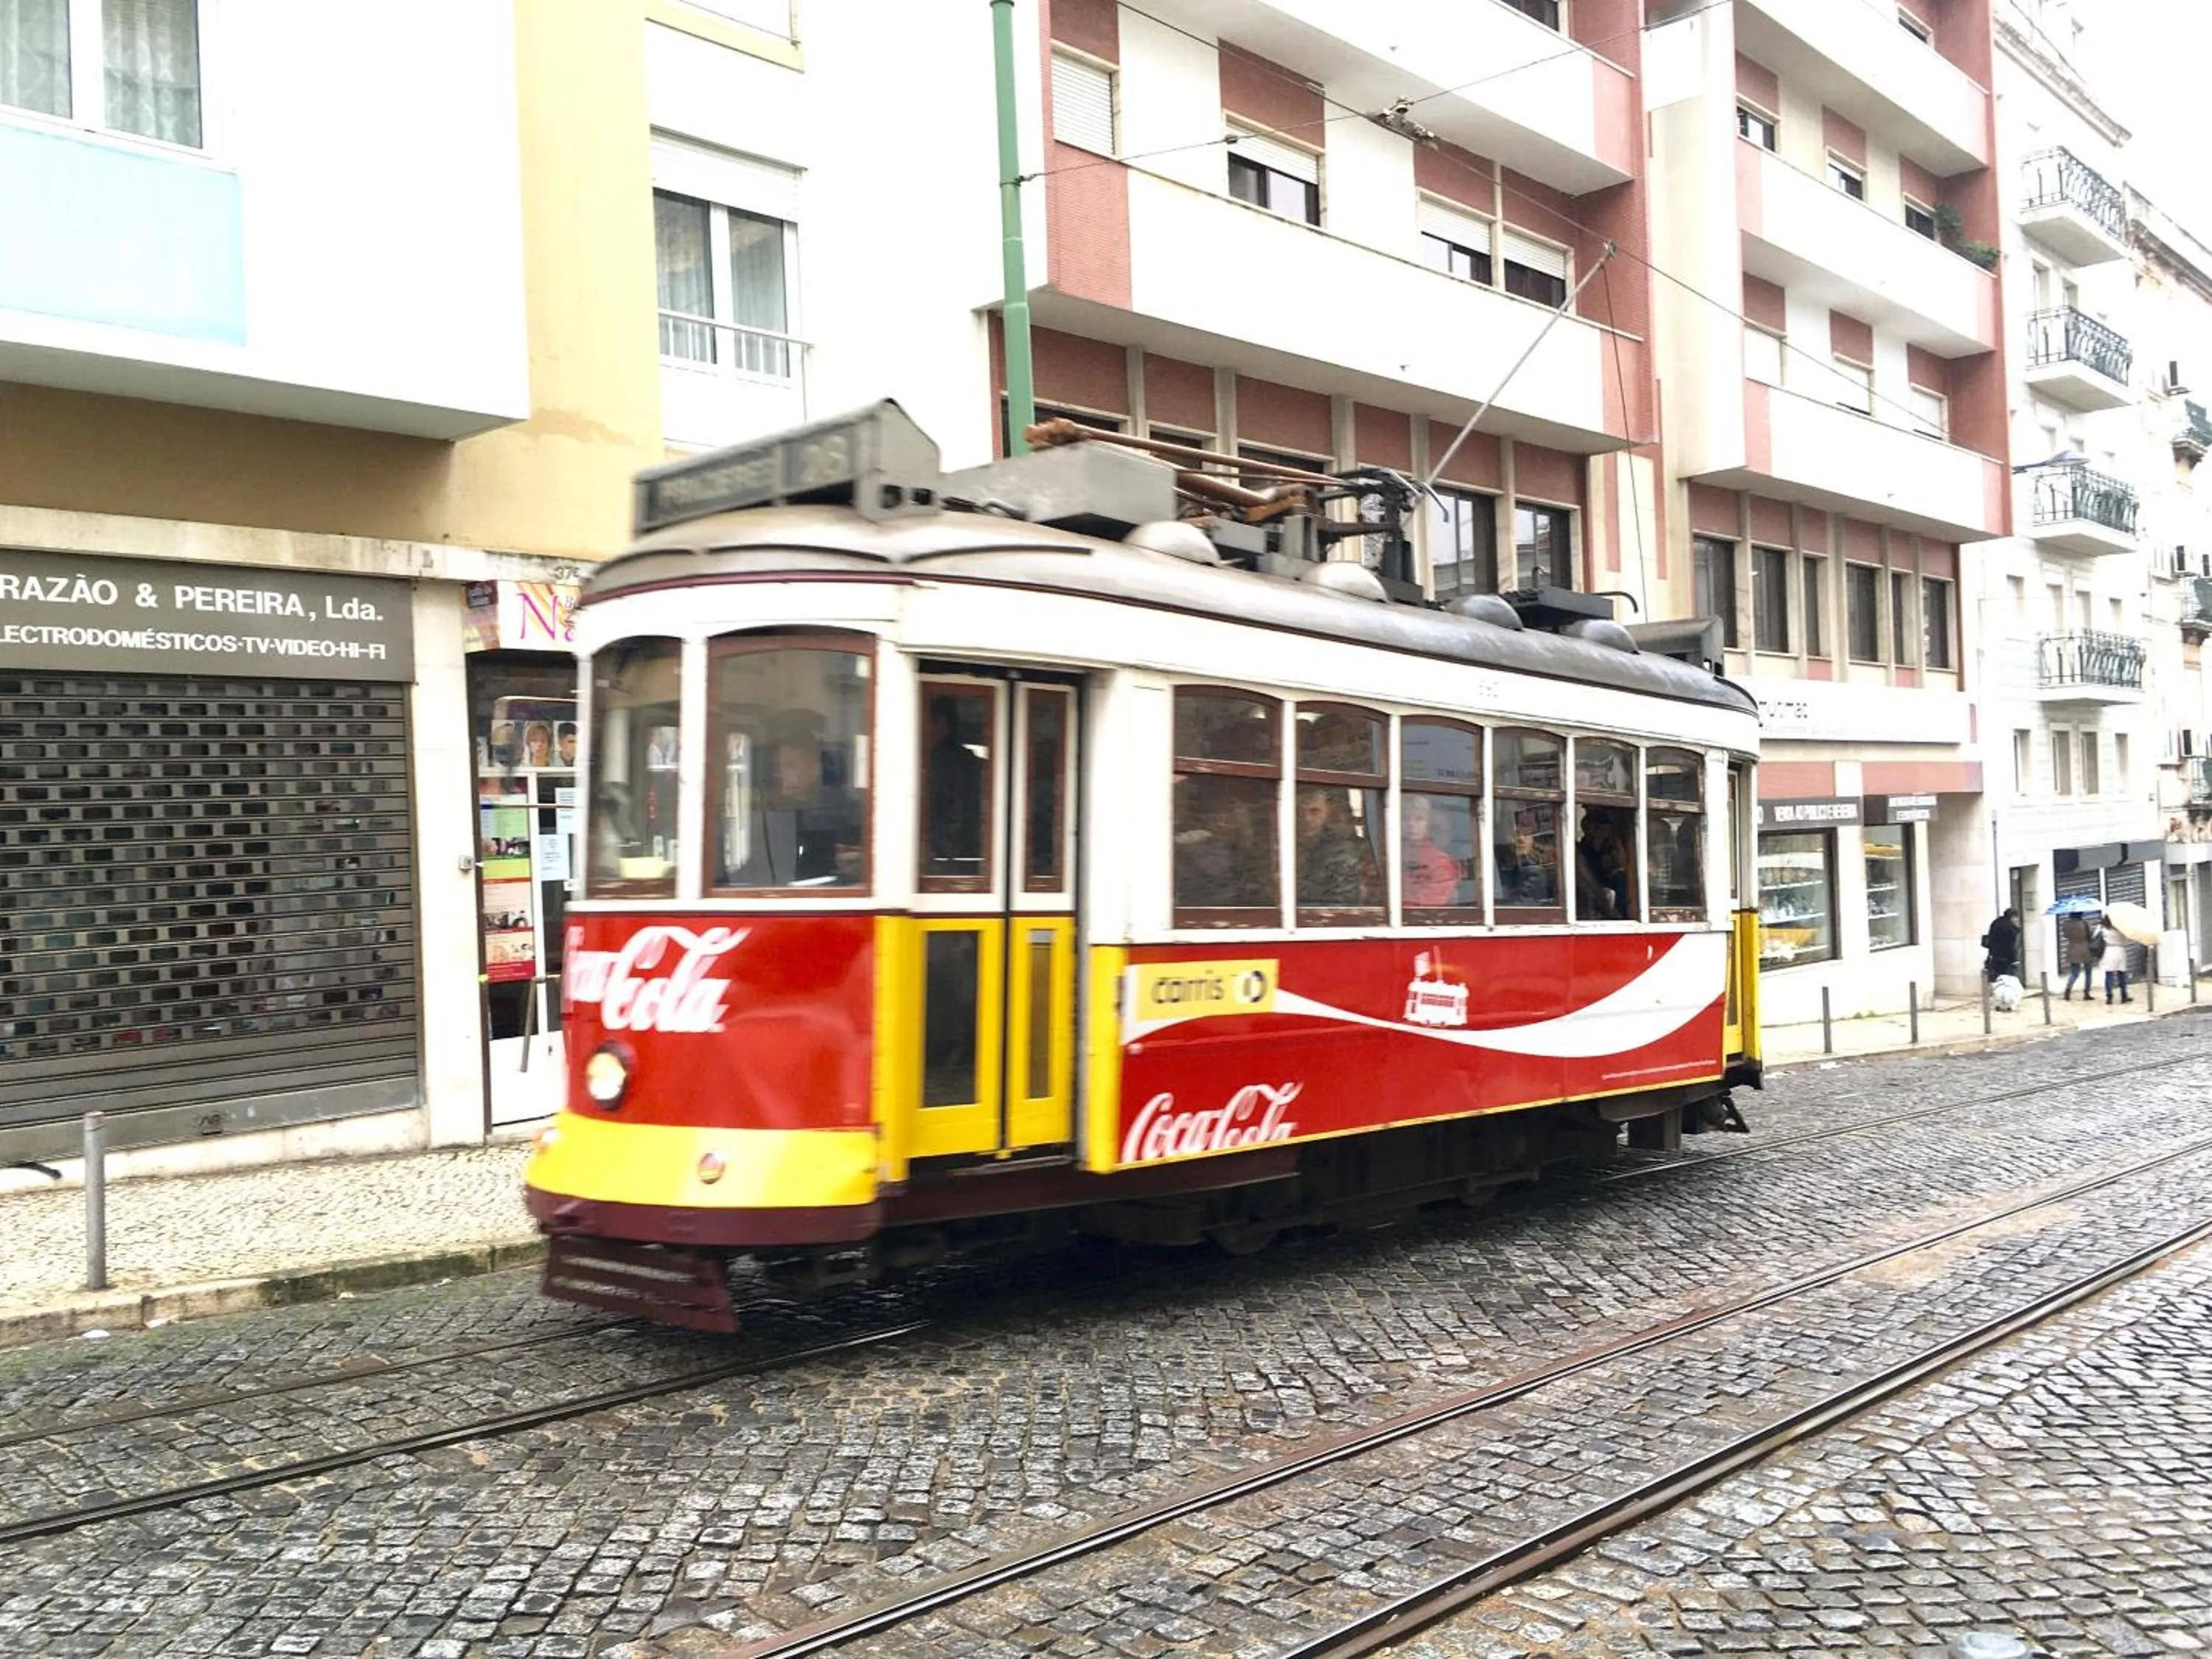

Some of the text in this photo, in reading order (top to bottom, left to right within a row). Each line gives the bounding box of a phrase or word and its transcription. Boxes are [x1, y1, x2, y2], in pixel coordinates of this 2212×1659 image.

[0, 574, 118, 605] RAZÃO
[135, 582, 158, 608] &
[325, 595, 383, 621] Lda.
[1150, 969, 1225, 1004] carris
